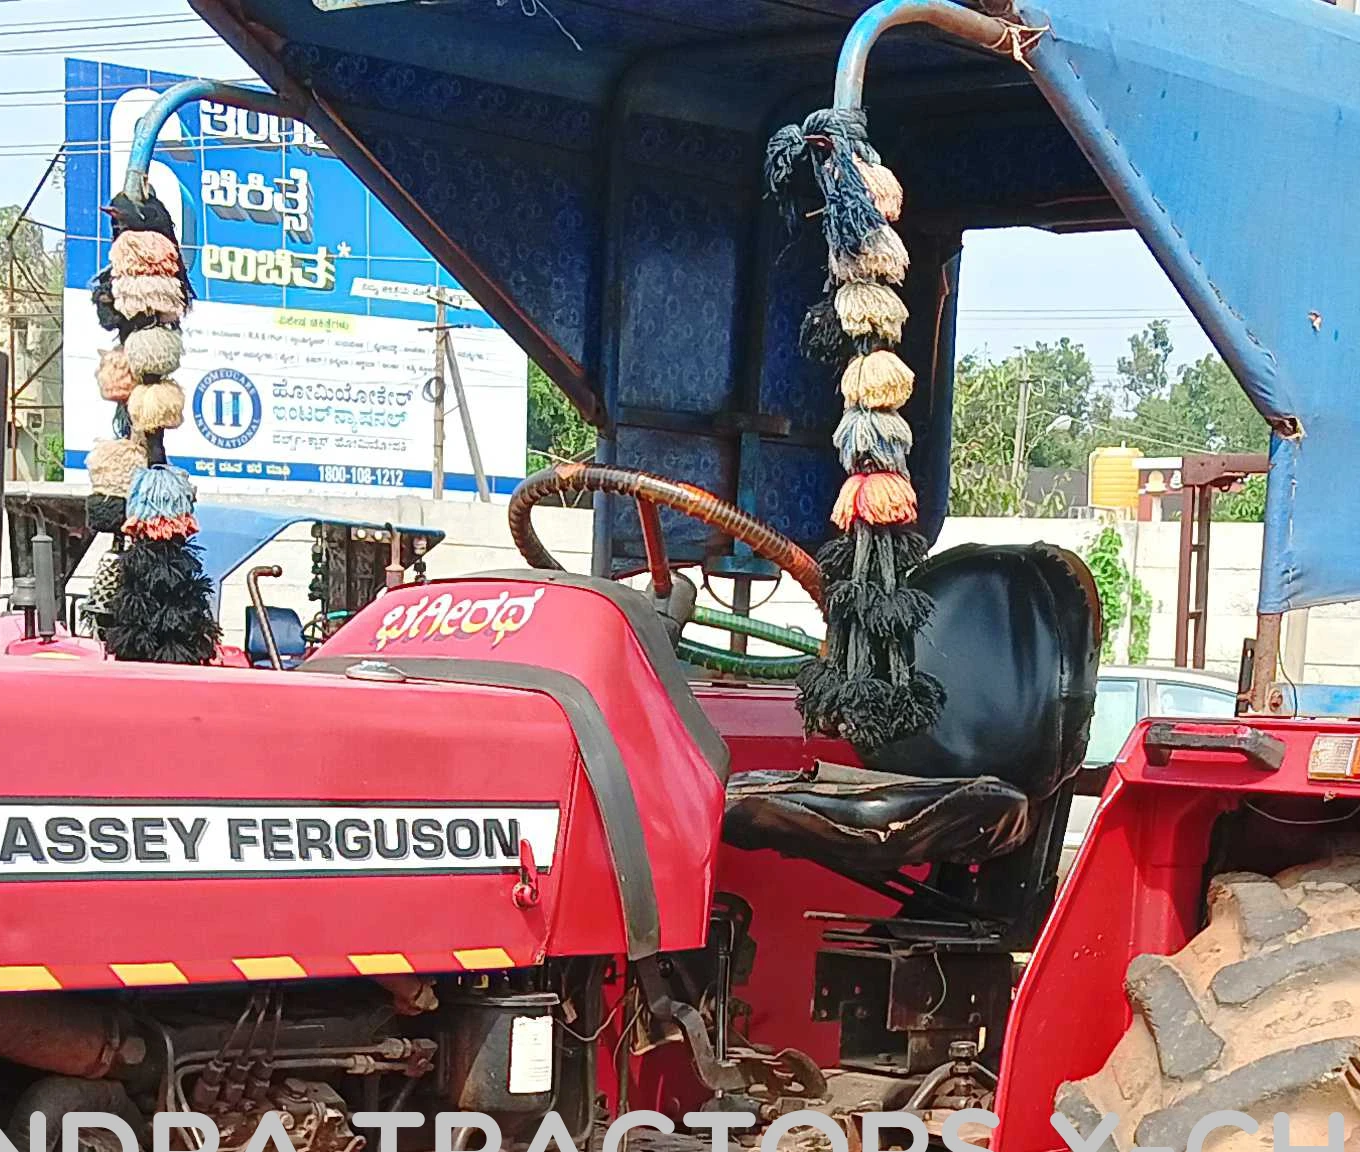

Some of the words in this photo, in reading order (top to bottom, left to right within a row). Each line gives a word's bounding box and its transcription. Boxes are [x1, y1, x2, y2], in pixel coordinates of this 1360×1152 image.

[194, 413, 260, 449] INTERNATIONAL
[317, 465, 404, 487] 1800-108-1212
[228, 817, 522, 862] FERGUSON
